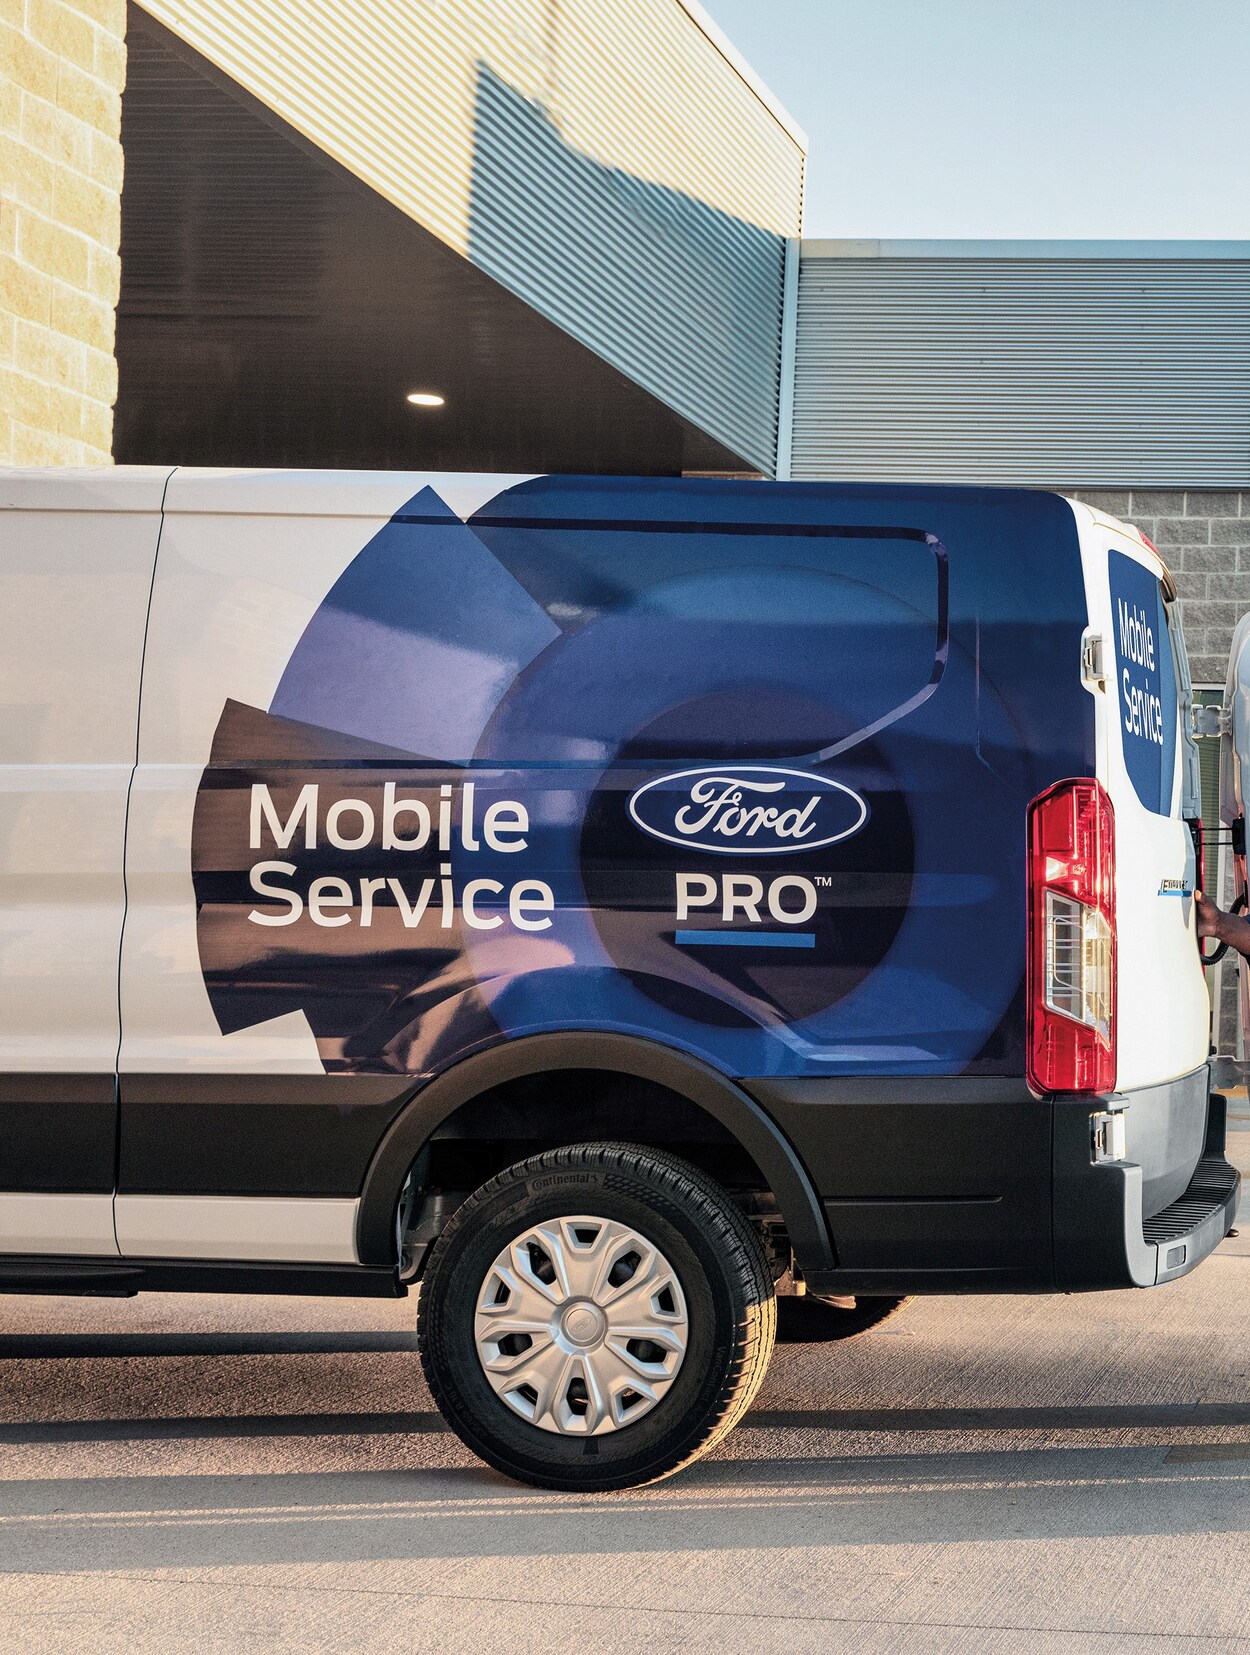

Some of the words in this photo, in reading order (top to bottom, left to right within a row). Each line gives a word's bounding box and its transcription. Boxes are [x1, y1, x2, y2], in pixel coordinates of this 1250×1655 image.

[1118, 597, 1155, 672] Mobile
[1123, 667, 1163, 746] Service
[249, 781, 529, 853] Mobile
[674, 777, 822, 839] Ford
[247, 860, 555, 932] Service
